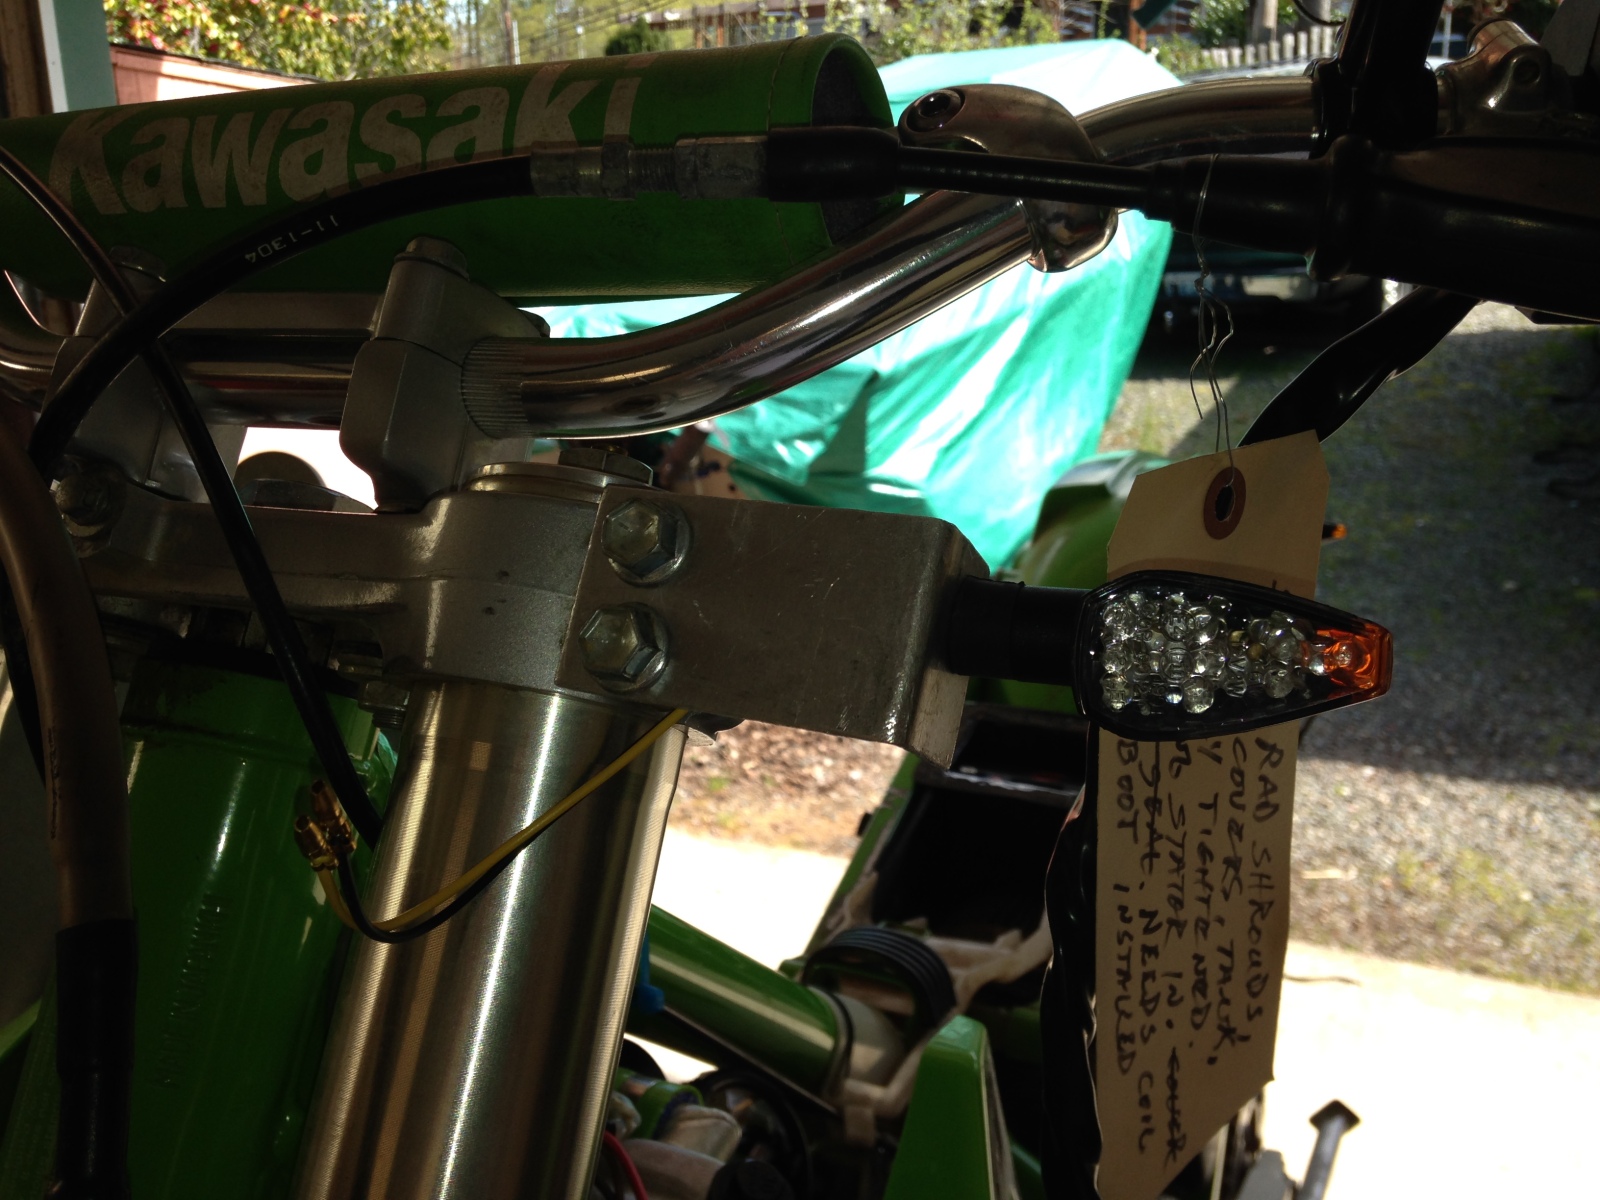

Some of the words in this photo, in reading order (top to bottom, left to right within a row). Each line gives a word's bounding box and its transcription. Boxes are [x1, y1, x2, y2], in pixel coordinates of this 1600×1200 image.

[50, 53, 660, 215] Kawasaki
[245, 214, 338, 263] 11-1304
[1117, 739, 1139, 844] BOOT
[1252, 737, 1284, 823] RAD
[1139, 908, 1163, 1044] NEEDS
